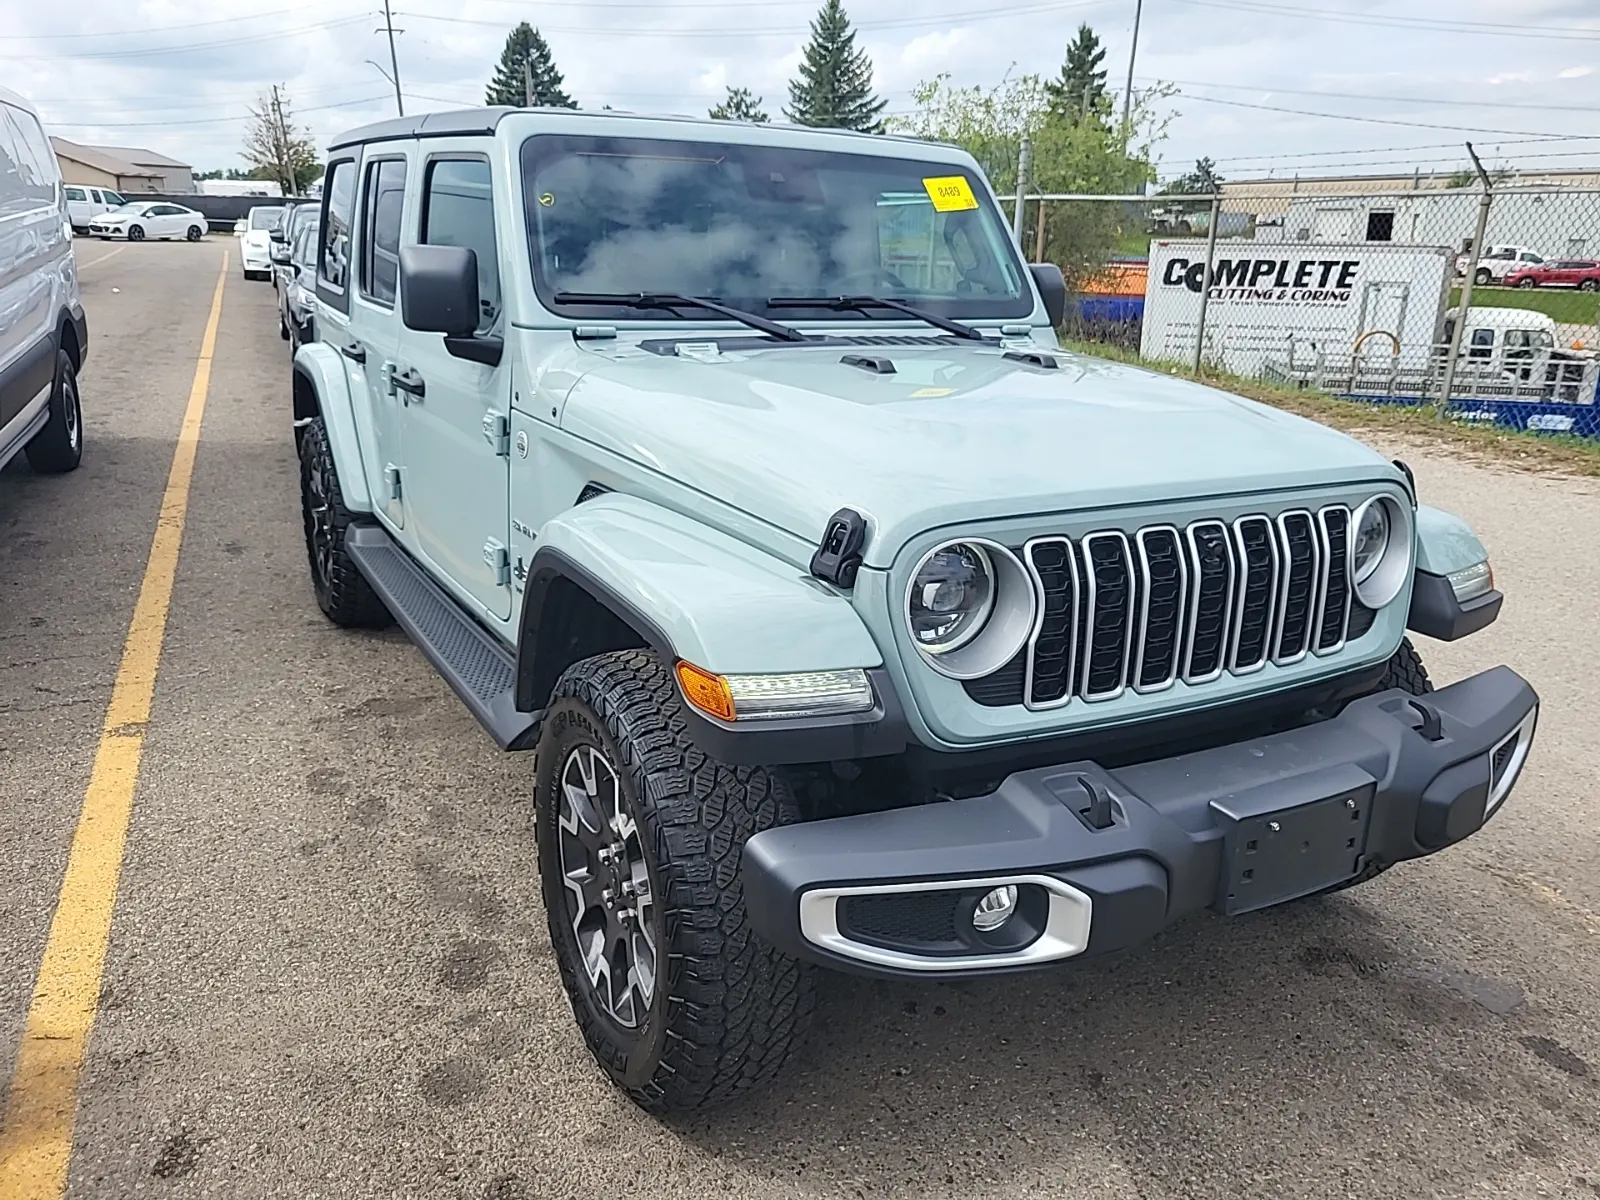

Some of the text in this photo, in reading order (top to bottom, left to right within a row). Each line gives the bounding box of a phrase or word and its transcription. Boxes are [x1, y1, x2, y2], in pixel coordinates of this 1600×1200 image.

[938, 186, 961, 198] 8489
[1163, 258, 1360, 293] COMPLETE
[1208, 288, 1351, 302] CUTTING & CORING
